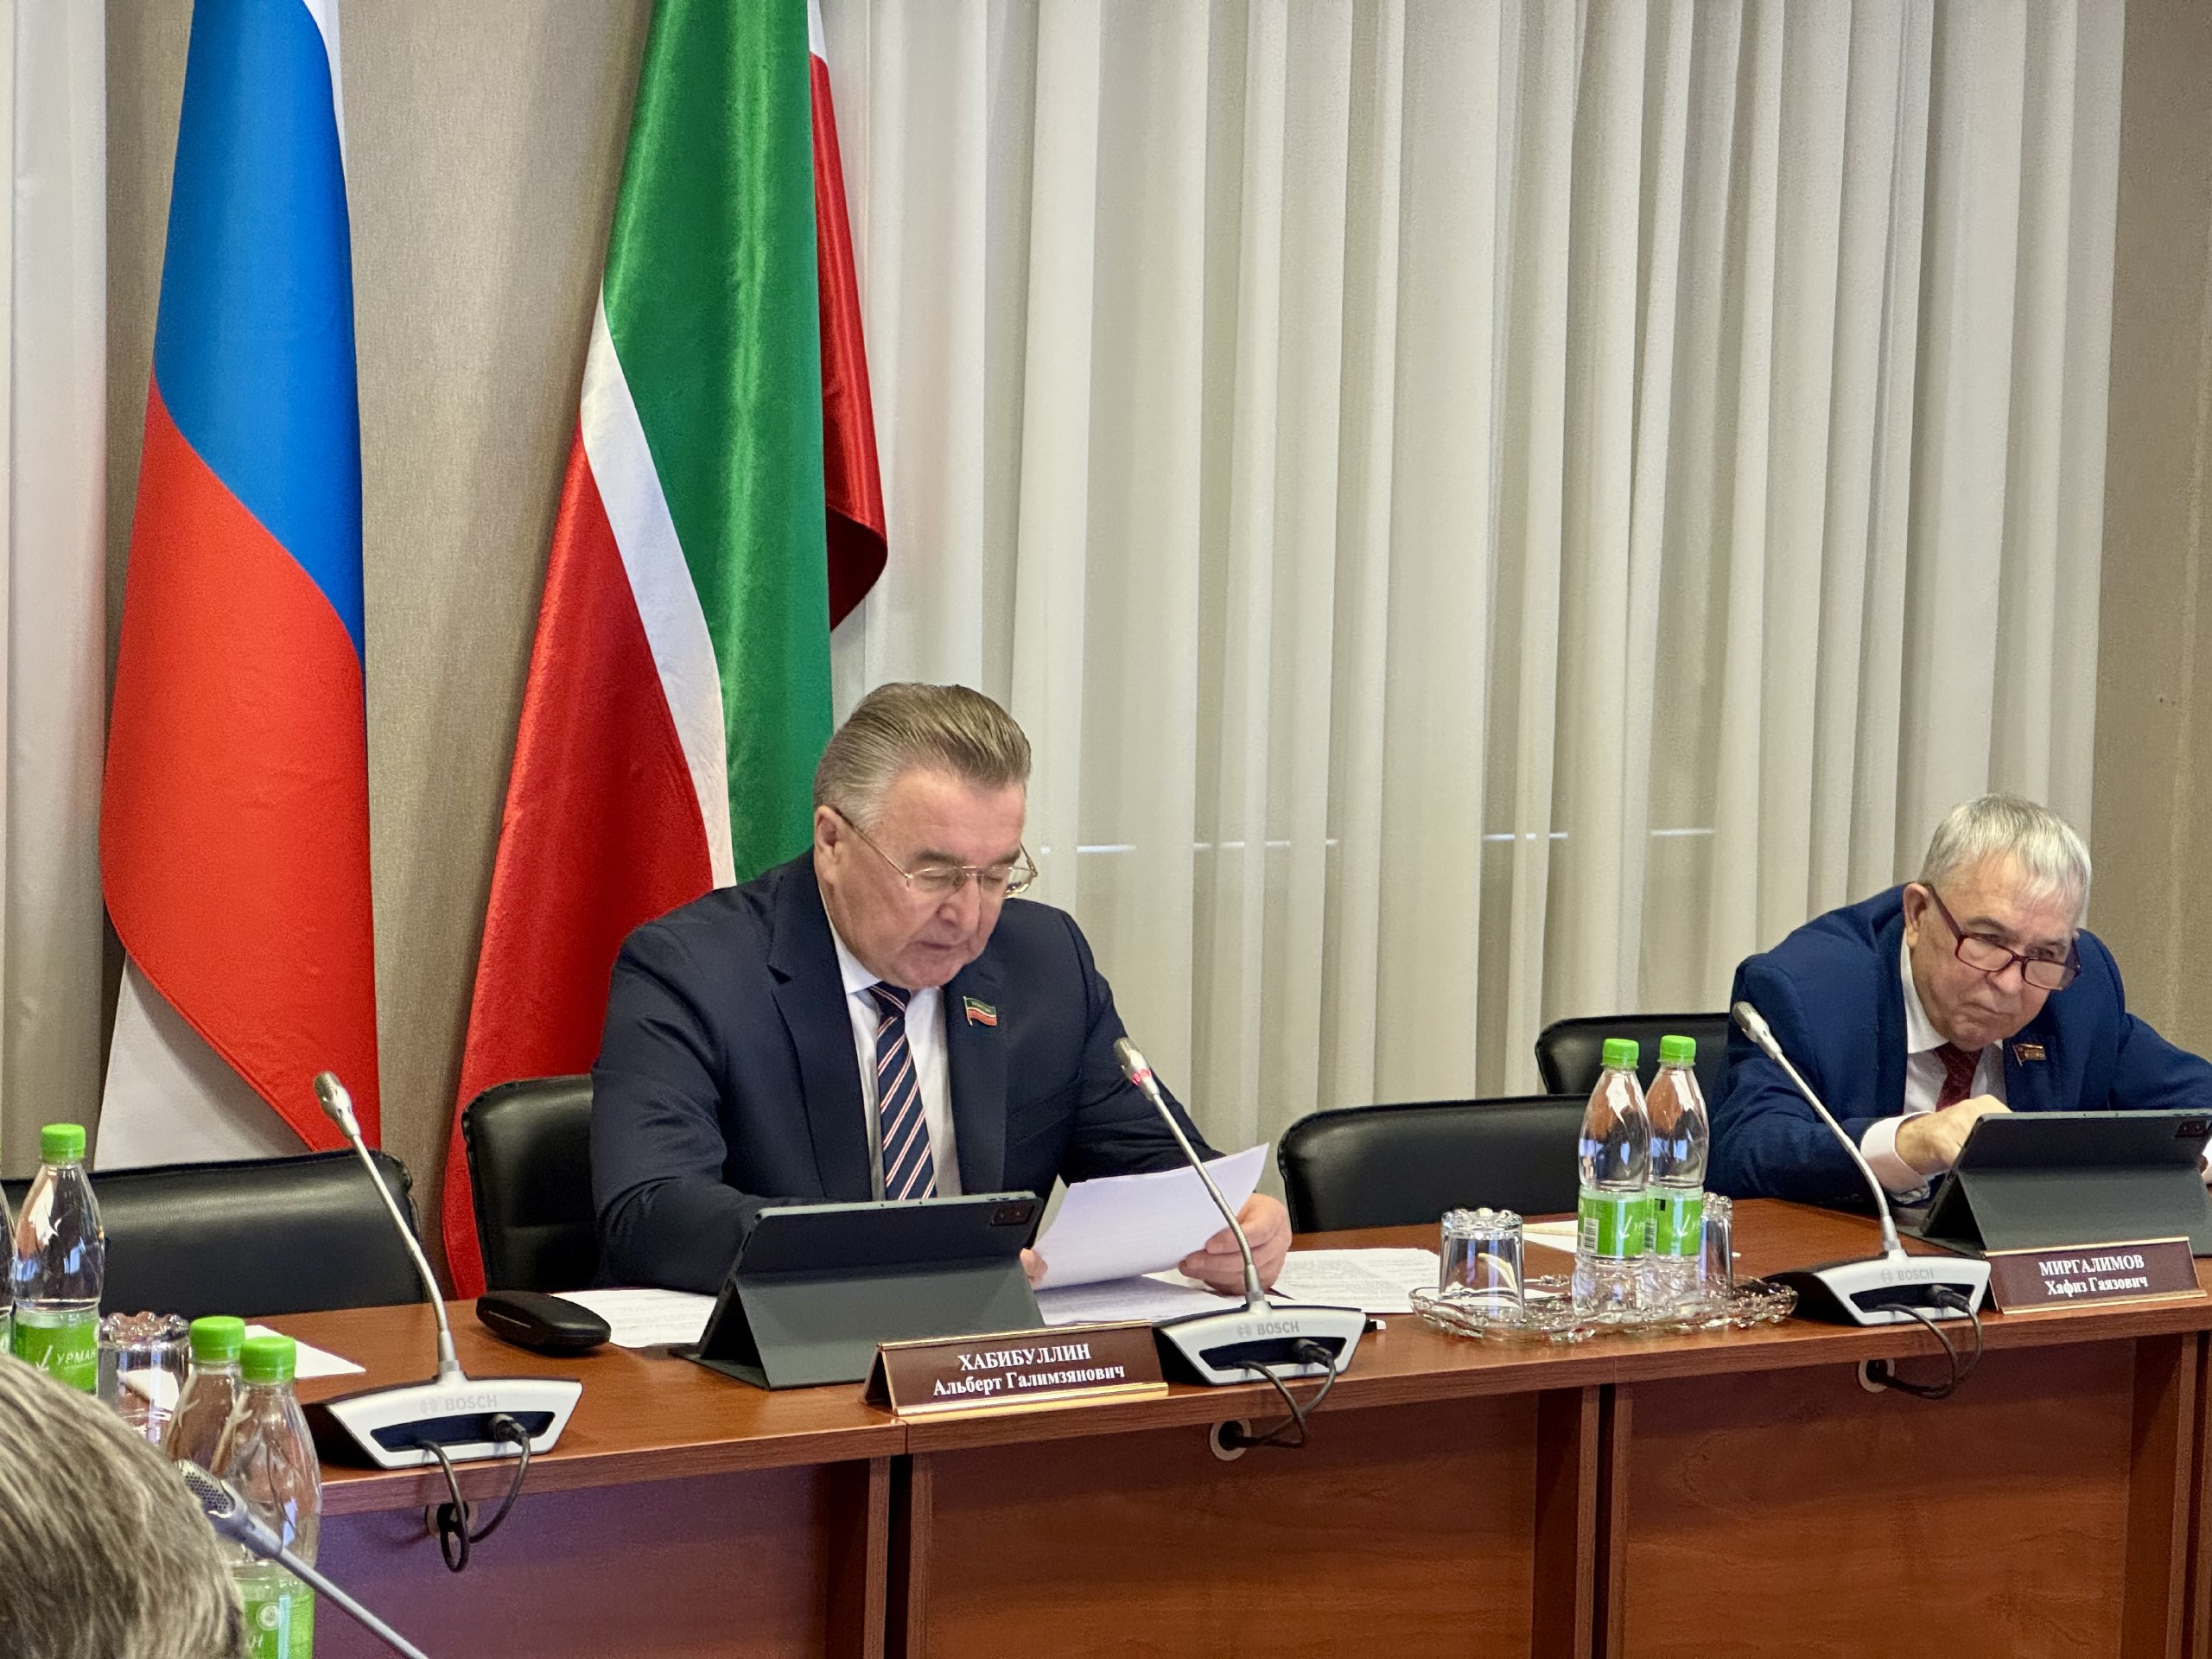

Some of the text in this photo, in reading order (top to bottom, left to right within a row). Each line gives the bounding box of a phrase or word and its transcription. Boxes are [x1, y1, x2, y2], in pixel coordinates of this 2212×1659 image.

[1897, 1268, 1936, 1281] BOSCH
[2038, 1255, 2145, 1276] МИРГАЛИМОВ
[2045, 1275, 2149, 1298] Хафиз Гаязович
[1256, 1321, 1300, 1336] BOSCH
[958, 1344, 1092, 1371] ХАБИБУЛЛИН
[933, 1363, 1126, 1396] Альберт Галимзянович
[445, 1394, 498, 1412] BOSCH
